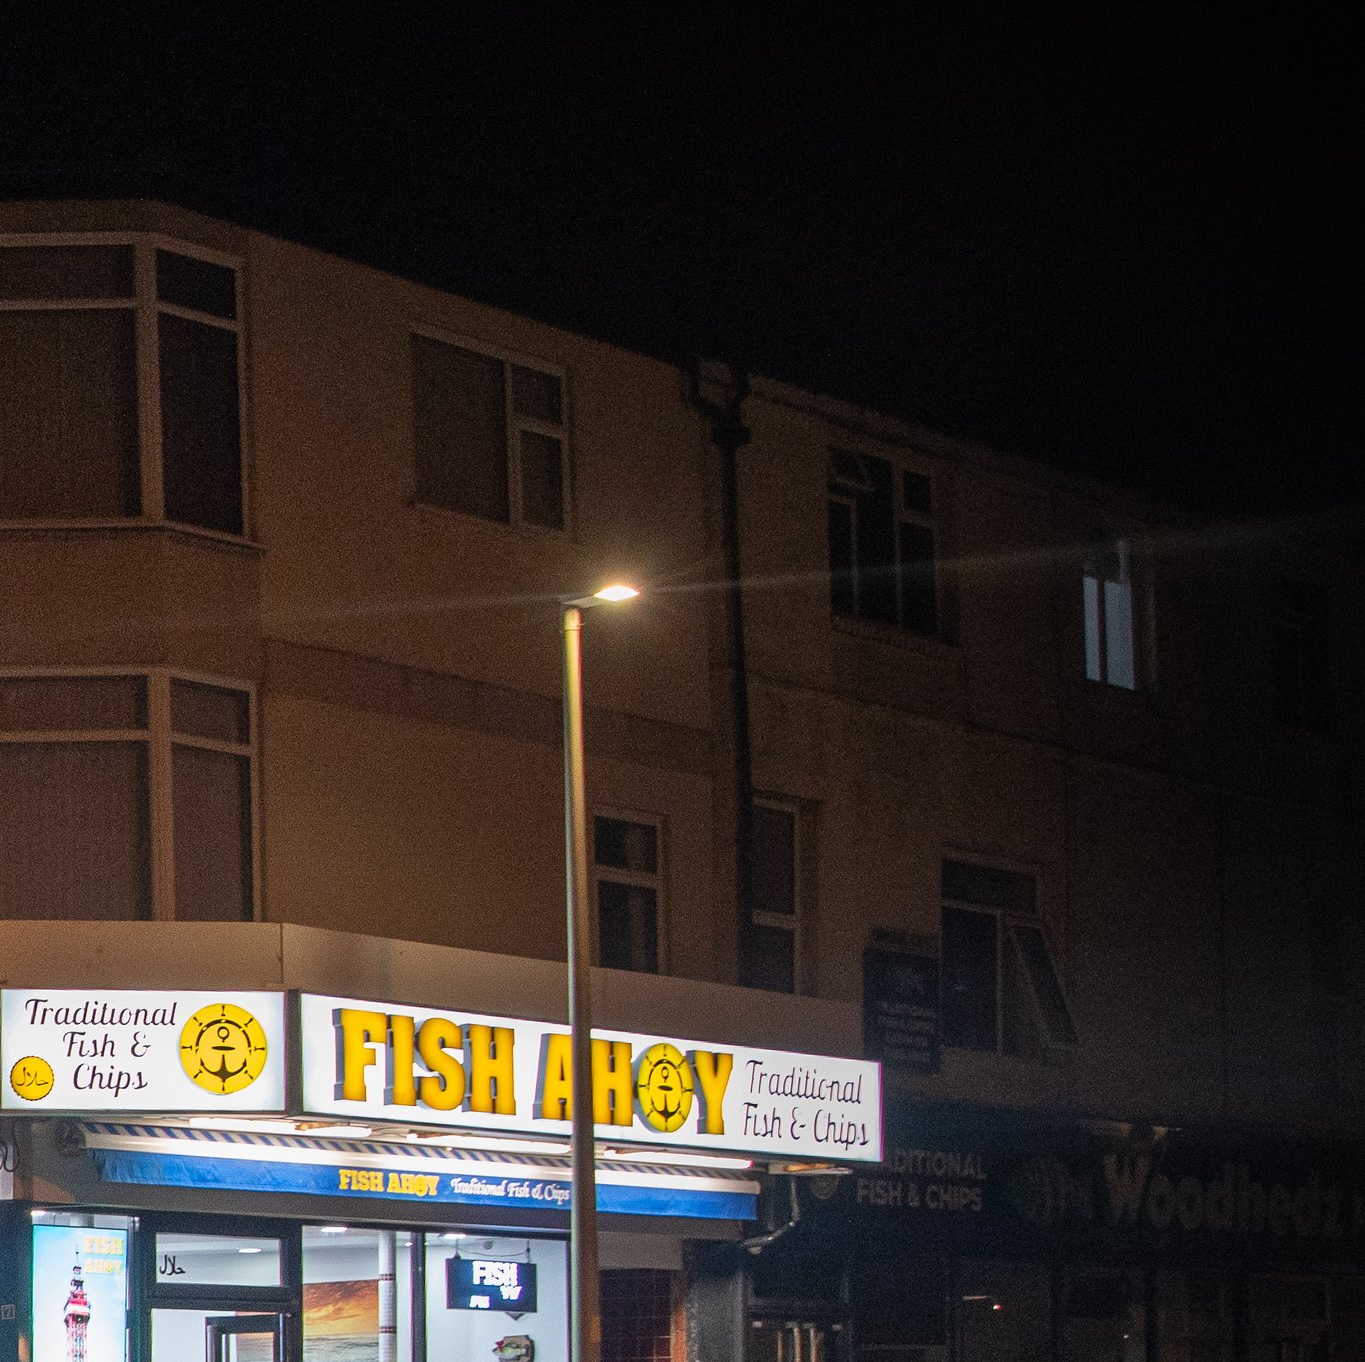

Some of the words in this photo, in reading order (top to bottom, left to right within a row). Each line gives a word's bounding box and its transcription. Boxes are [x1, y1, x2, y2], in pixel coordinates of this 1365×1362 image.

[23, 997, 178, 1027] Traditional
[62, 1030, 116, 1058] Fish
[130, 1031, 152, 1058] &
[333, 1006, 518, 1116] FISH
[72, 1062, 149, 1098] Chips
[744, 1059, 864, 1106] Traditional
[743, 1102, 783, 1140] Fish
[812, 1110, 871, 1152] Chips
[339, 1168, 384, 1193] FISH
[387, 1172, 440, 1197] AHOY
[450, 1176, 506, 1197] Traditional
[507, 1179, 530, 1199] Fish
[855, 1177, 903, 1207] FISH
[925, 1183, 983, 1213] CHIPS
[84, 1236, 125, 1256] FISH
[84, 1259, 123, 1275] AHOY
[159, 1254, 187, 1276] حلال
[471, 1260, 518, 1287] FISH
